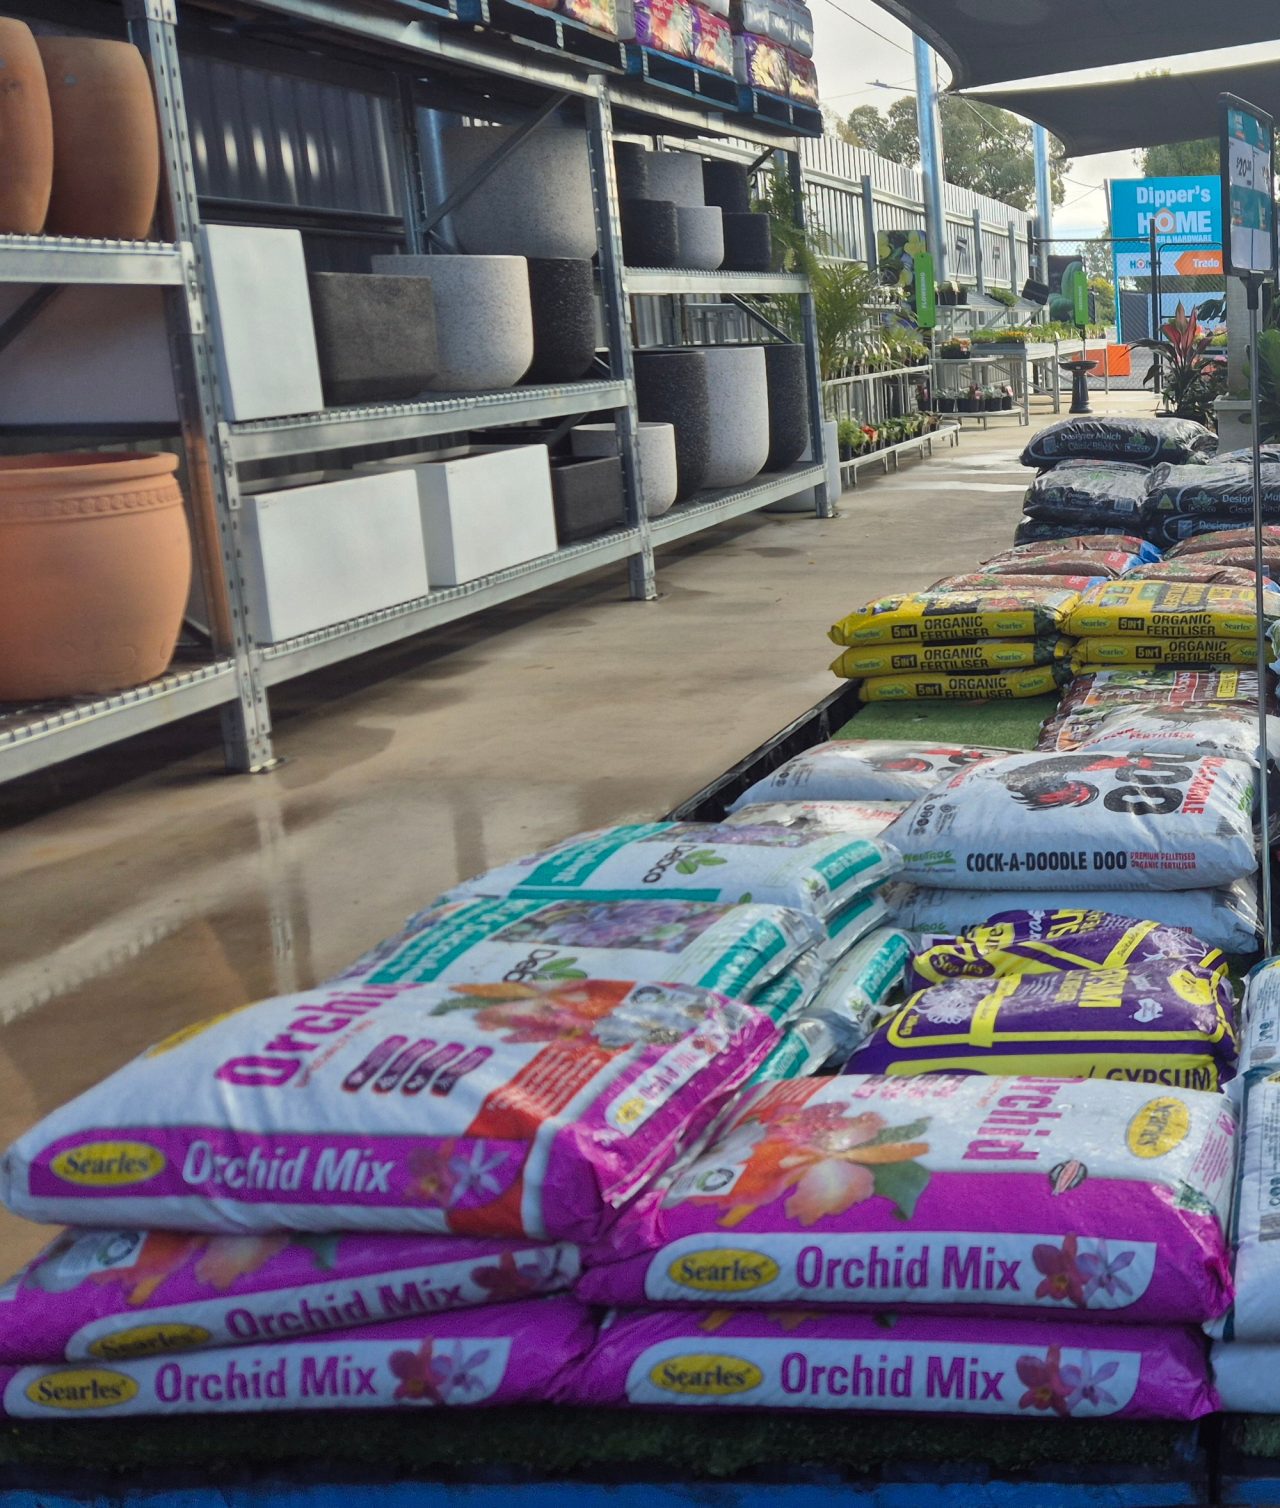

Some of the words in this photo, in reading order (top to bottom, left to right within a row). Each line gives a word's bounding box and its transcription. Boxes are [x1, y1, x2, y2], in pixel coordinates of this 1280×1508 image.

[1136, 185, 1211, 207] Dipper's
[1137, 210, 1212, 234] HOME
[1192, 259, 1220, 268] Trade
[1222, 494, 1254, 504] Design
[924, 616, 983, 629] ORGANIC
[1152, 614, 1211, 626] ORGANIC
[1224, 621, 1252, 631] Searles
[921, 627, 989, 641] FERTILISER
[1147, 625, 1216, 636] FERTILISER
[1169, 640, 1227, 652] ORGANIC
[1240, 648, 1258, 657] Sear
[924, 647, 983, 660] ORGANIC
[1164, 651, 1231, 663] FERTILISER
[921, 658, 989, 671] FERTILISER
[949, 677, 1007, 690] ORGANIC
[945, 688, 1014, 700] FERTILISER
[966, 851, 1088, 872] COCK-A-DOODLE
[1093, 850, 1127, 870] DOO
[1130, 852, 1159, 860] PREMIUM
[1161, 852, 1196, 861] PELLETISED
[1131, 861, 1159, 869] ORGANIC
[1160, 862, 1196, 870] FERTILISER
[933, 954, 985, 974] Seales
[1105, 1066, 1212, 1091] GYPSUM
[63, 1148, 152, 1176] Searles
[182, 1140, 308, 1191] Orchid
[312, 1147, 395, 1193] Mix
[678, 1260, 763, 1283] Searles
[796, 1245, 928, 1291] Orchid
[942, 1246, 1022, 1292] Mix
[225, 1290, 372, 1340] Orchid
[380, 1279, 466, 1315] Mix
[37, 1379, 123, 1401] Searles
[154, 1358, 288, 1403] Orchid
[301, 1356, 378, 1400] Mix
[662, 1365, 748, 1389] Searles
[780, 1352, 913, 1398] Orchid
[926, 1355, 1006, 1402] Mix
